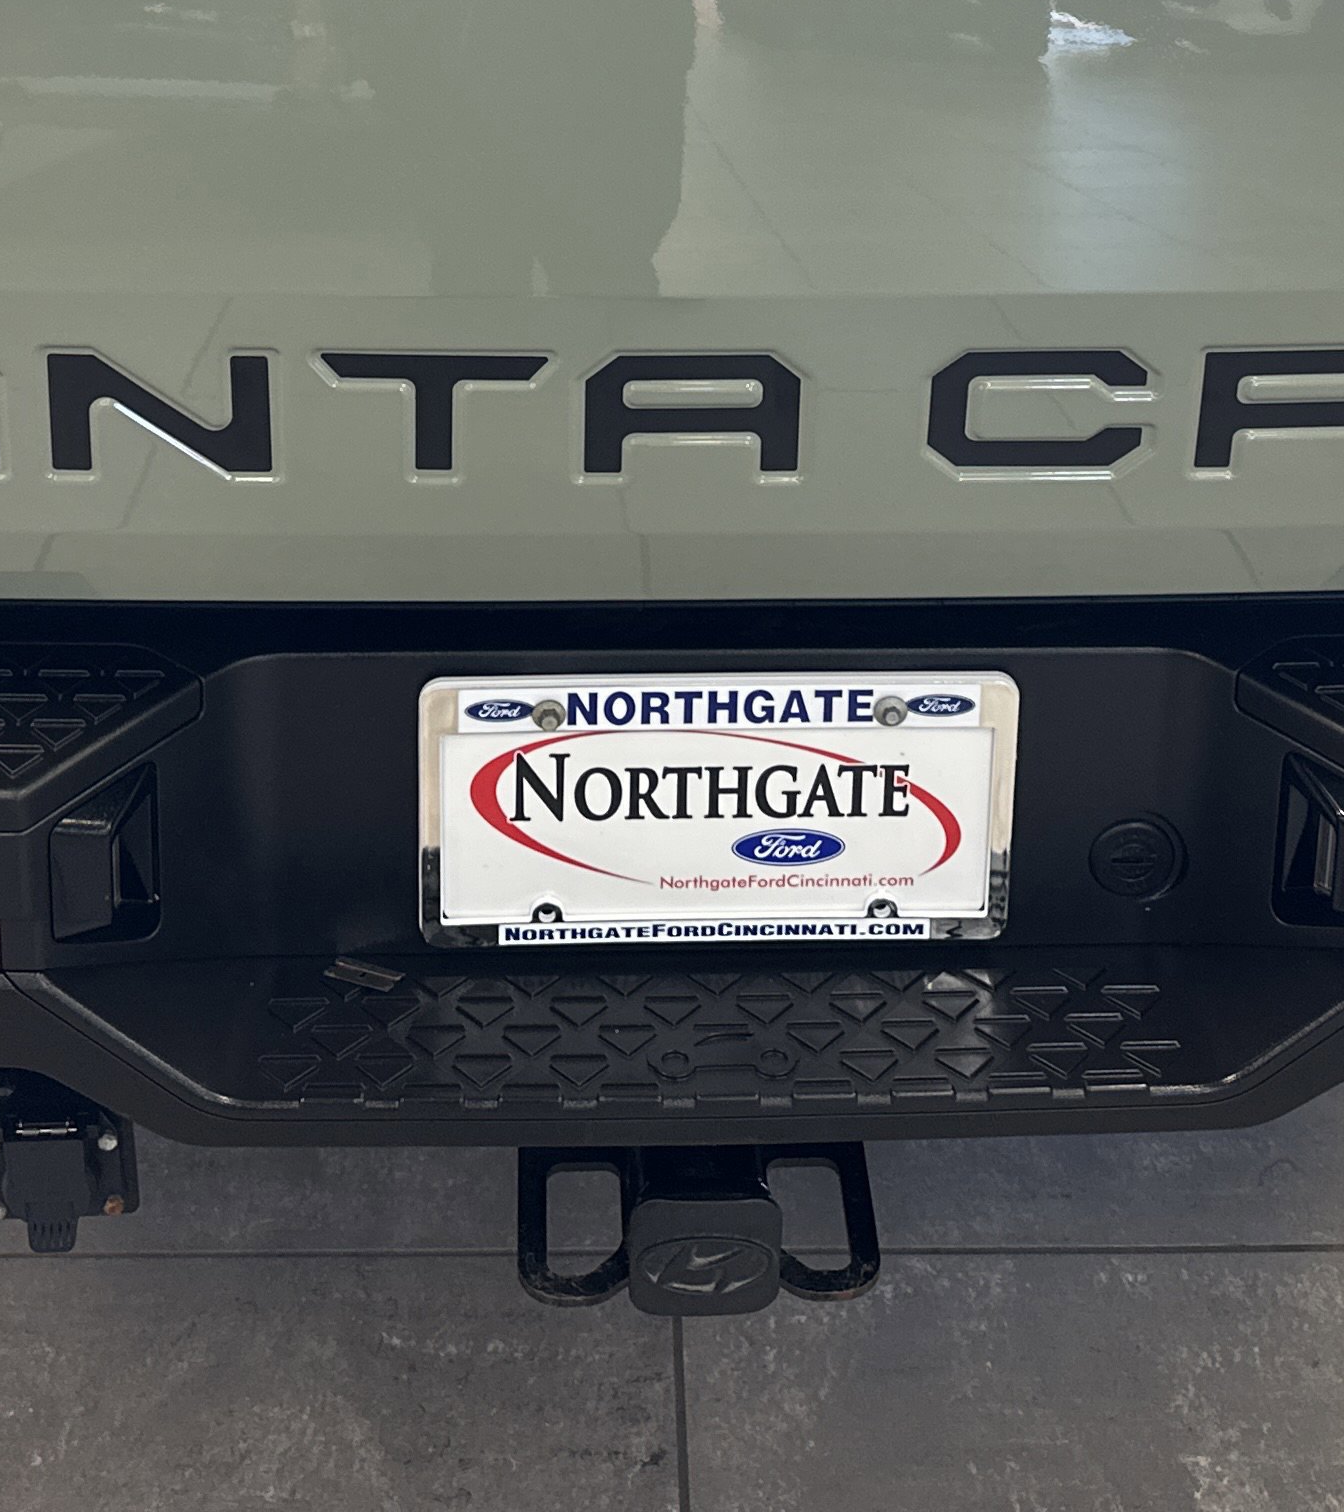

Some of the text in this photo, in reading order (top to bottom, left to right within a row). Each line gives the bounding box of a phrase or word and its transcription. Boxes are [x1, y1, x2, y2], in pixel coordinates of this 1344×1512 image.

[477, 689, 961, 726] Ford NORTHGATE Ford
[510, 752, 910, 822] NORTHGATE
[754, 833, 823, 859] Ford
[660, 873, 915, 892] NorthgateFordCincinnati.com
